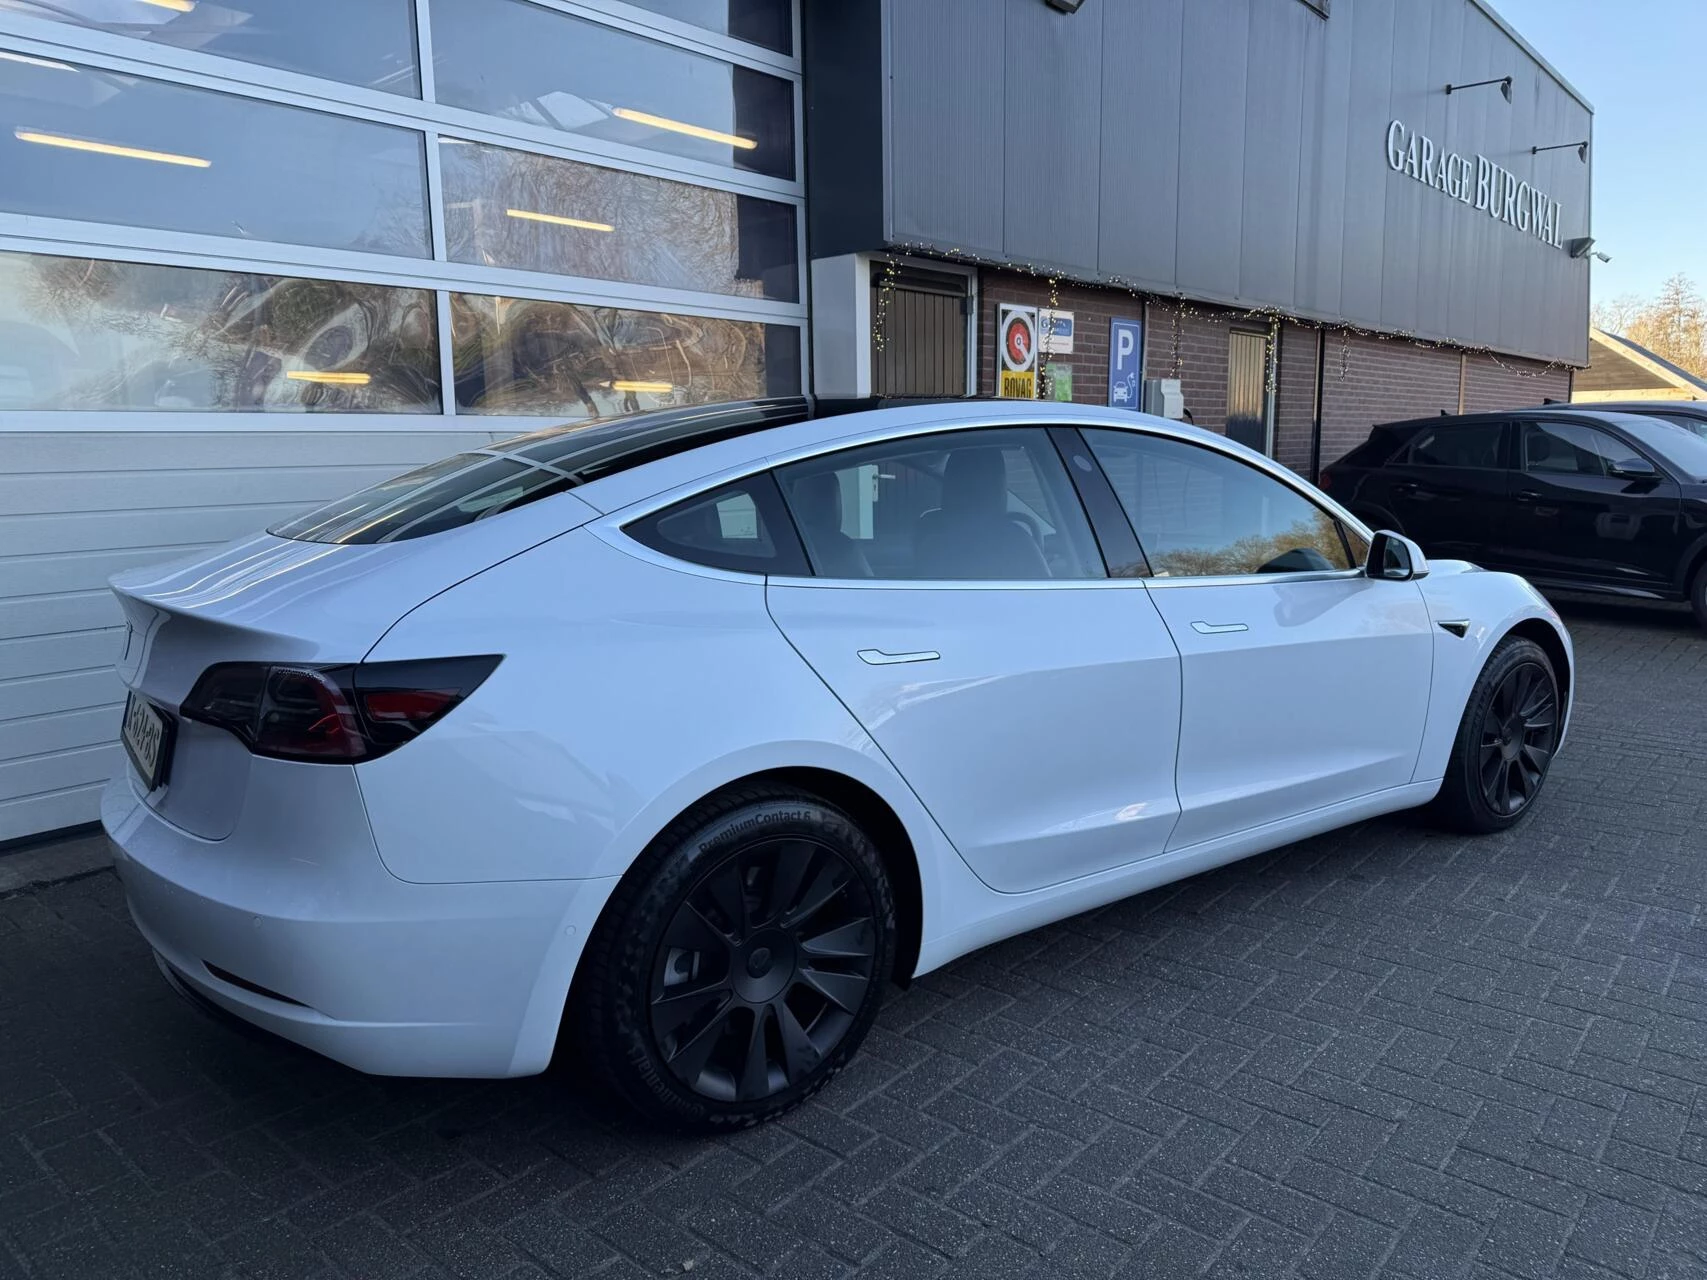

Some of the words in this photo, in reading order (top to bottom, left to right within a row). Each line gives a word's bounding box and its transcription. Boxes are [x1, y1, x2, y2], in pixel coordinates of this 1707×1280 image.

[1387, 119, 1472, 204] GARAGE
[1474, 154, 1564, 249] BURGWAL
[1117, 329, 1134, 370] P
[1004, 377, 1032, 399] BOVAG
[698, 810, 802, 853] PremiumContact
[803, 811, 811, 821] 6
